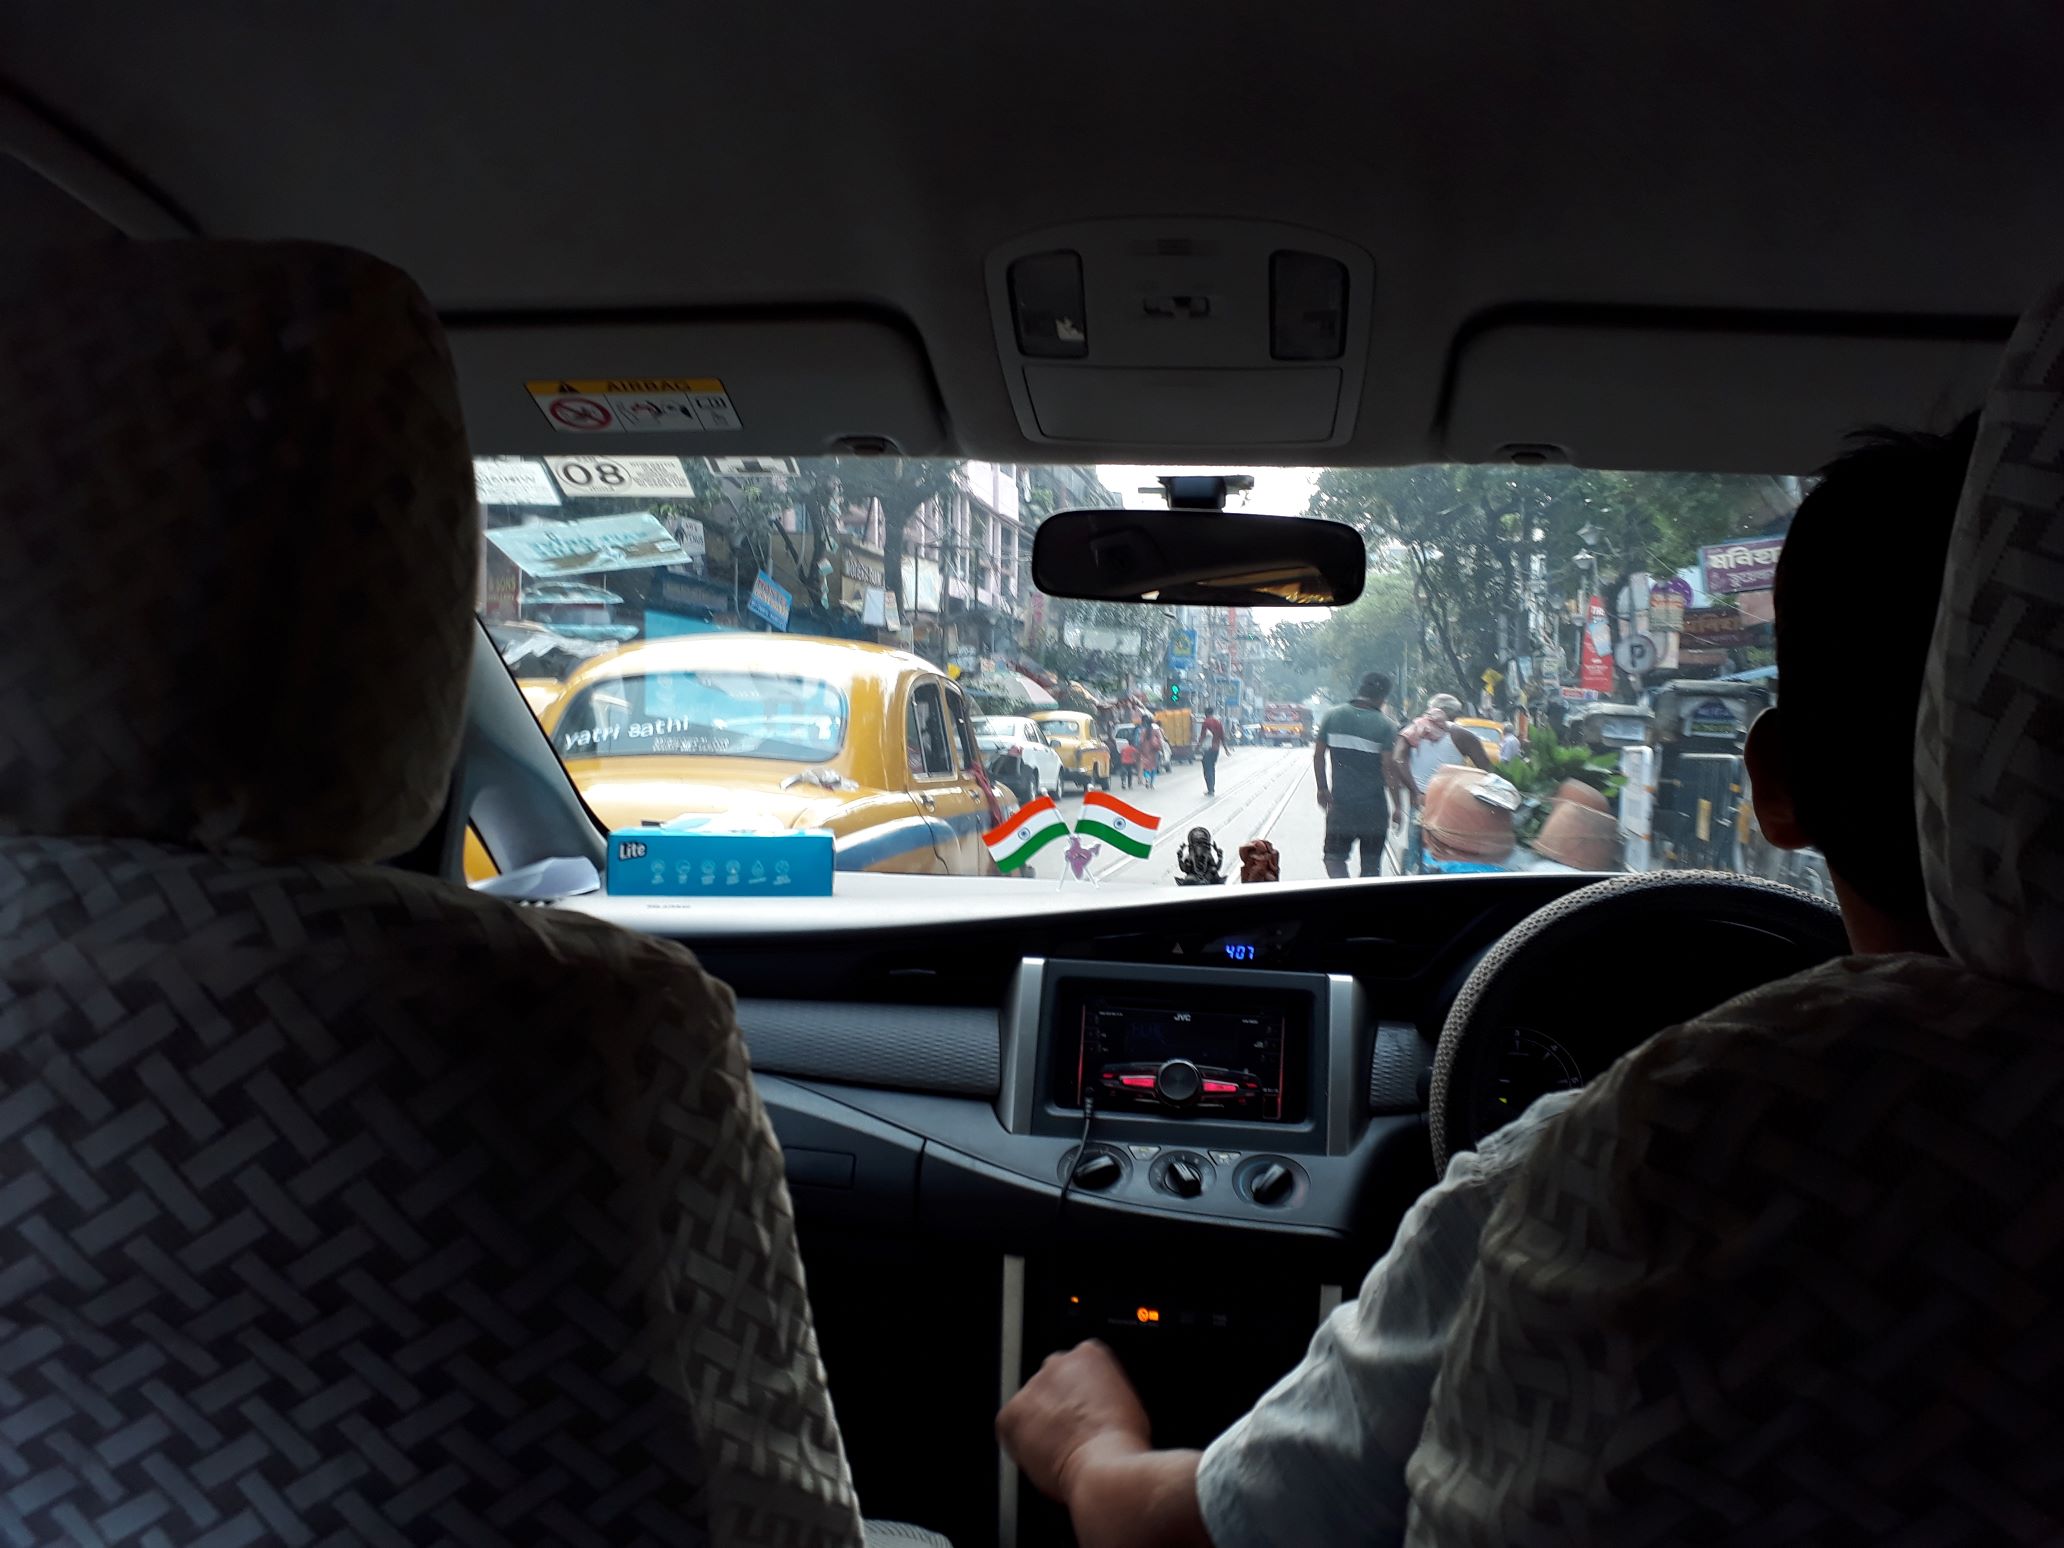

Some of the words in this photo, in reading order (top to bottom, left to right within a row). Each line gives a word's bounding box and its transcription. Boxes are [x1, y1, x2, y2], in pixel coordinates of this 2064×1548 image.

[607, 380, 693, 392] AIRBAG
[562, 462, 626, 486] 08
[1630, 644, 1645, 668] P
[619, 842, 646, 860] Lite
[1173, 1012, 1192, 1023] JVC
